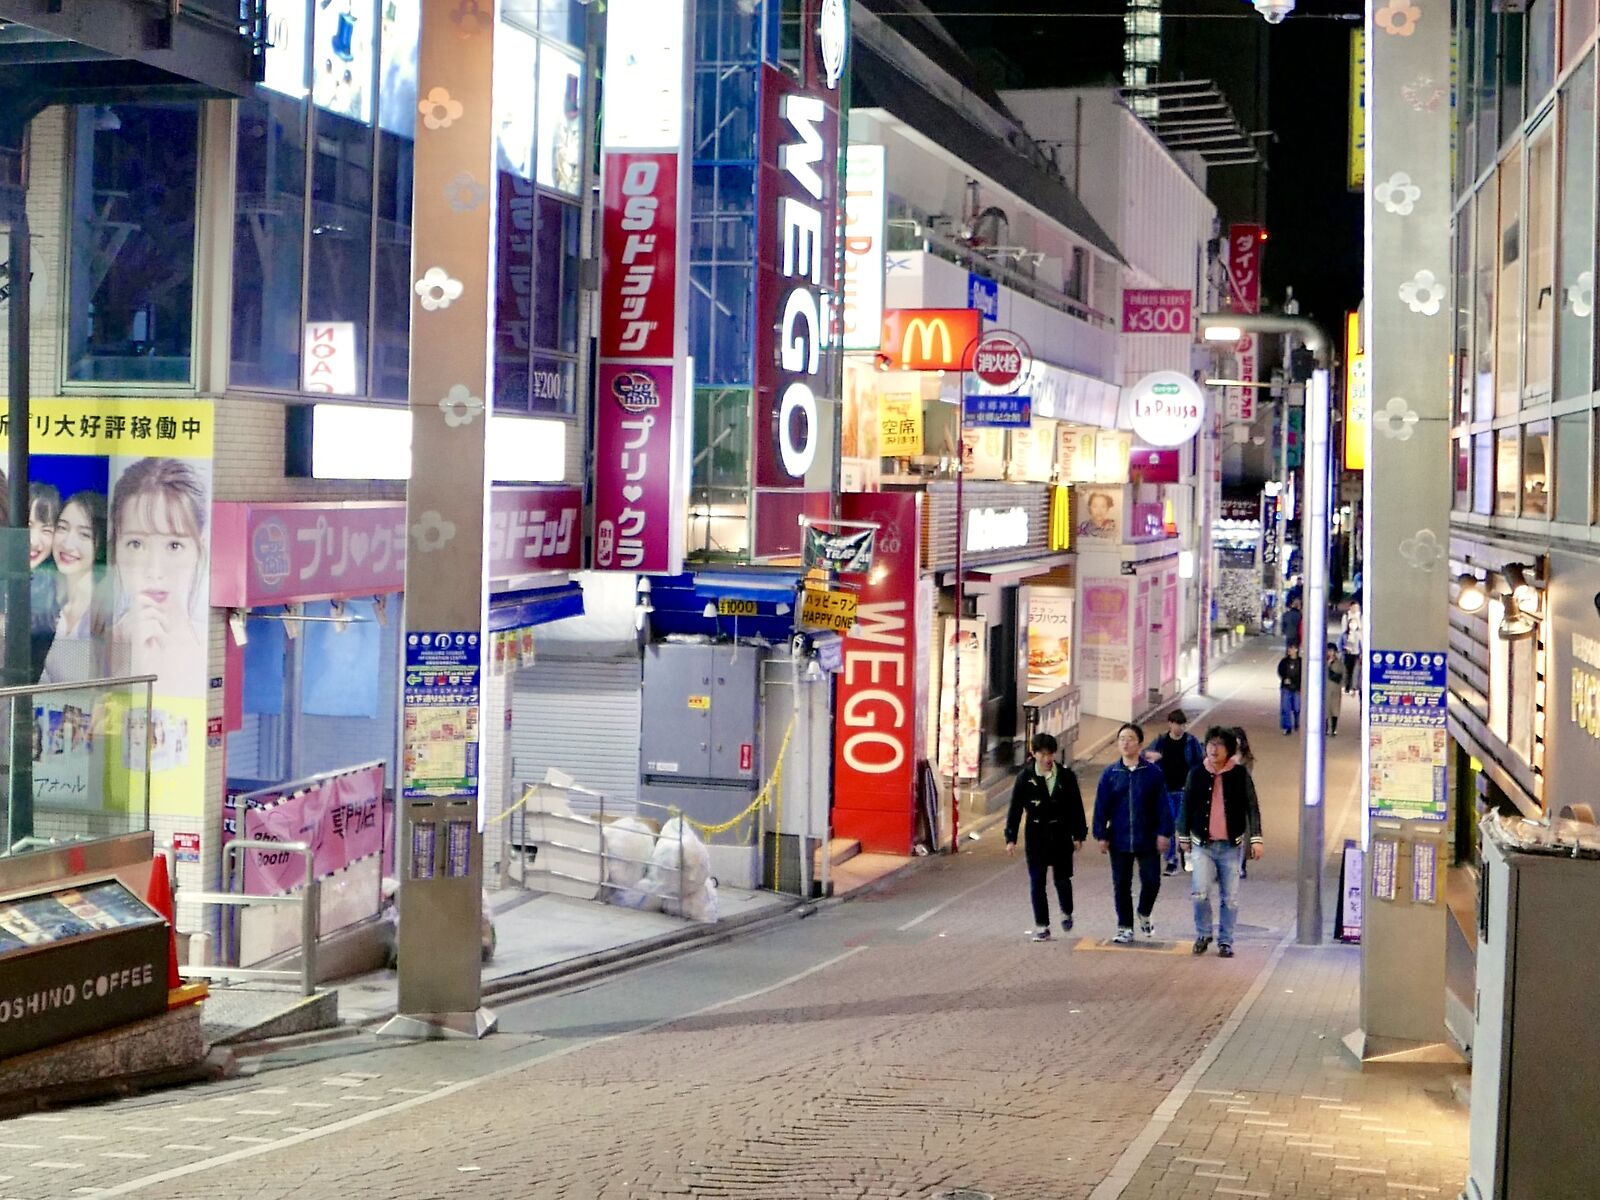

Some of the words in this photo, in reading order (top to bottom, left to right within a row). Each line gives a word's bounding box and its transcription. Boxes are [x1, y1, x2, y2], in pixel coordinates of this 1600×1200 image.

[618, 161, 661, 352] OSドラッグ
[1235, 233, 1254, 298] ダイソー
[780, 94, 826, 478] WEGO
[1128, 307, 1185, 331] ¥300
[978, 352, 1018, 373] 消火栓
[882, 419, 915, 435] 空席
[720, 599, 755, 615] ¥1000
[804, 594, 858, 611] ハッピーワン
[802, 610, 833, 627] HAPPY
[834, 615, 854, 630] ONE
[842, 601, 906, 774] WEGO
[82, 963, 153, 1000] COFFEE
